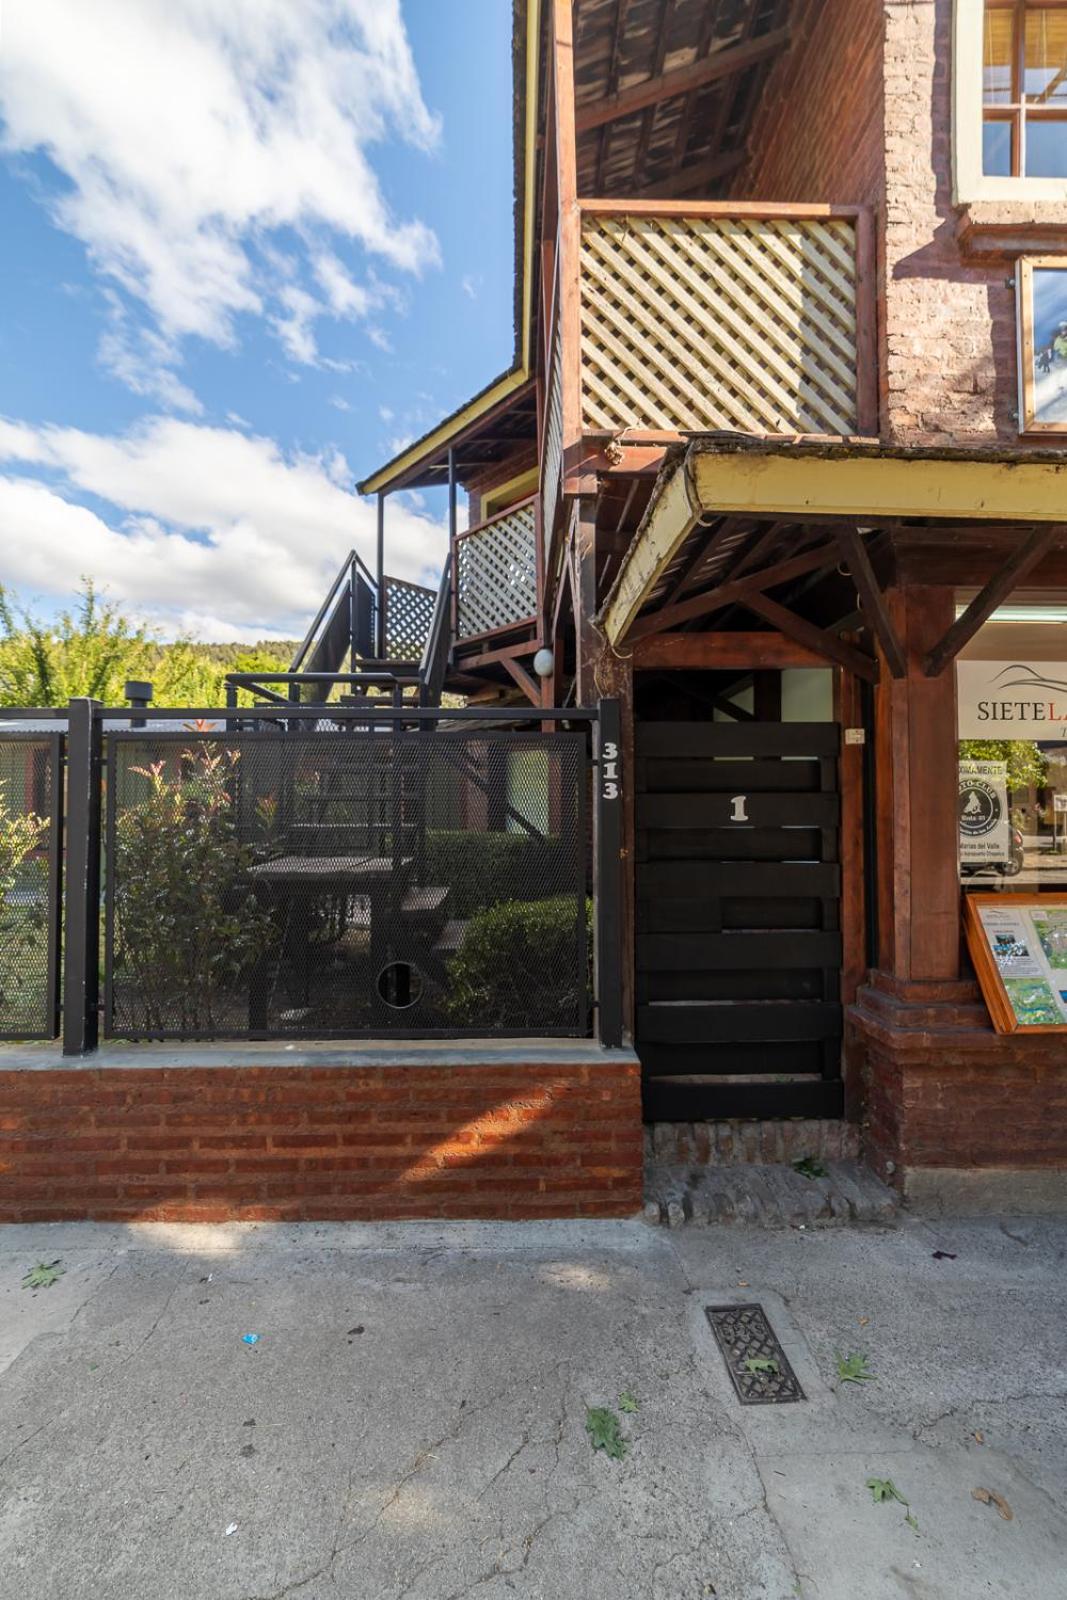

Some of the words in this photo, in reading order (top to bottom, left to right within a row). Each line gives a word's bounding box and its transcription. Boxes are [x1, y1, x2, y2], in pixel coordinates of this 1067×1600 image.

[977, 701, 1067, 721] SIETEL
[602, 742, 618, 800] 313
[730, 795, 749, 821] 1
